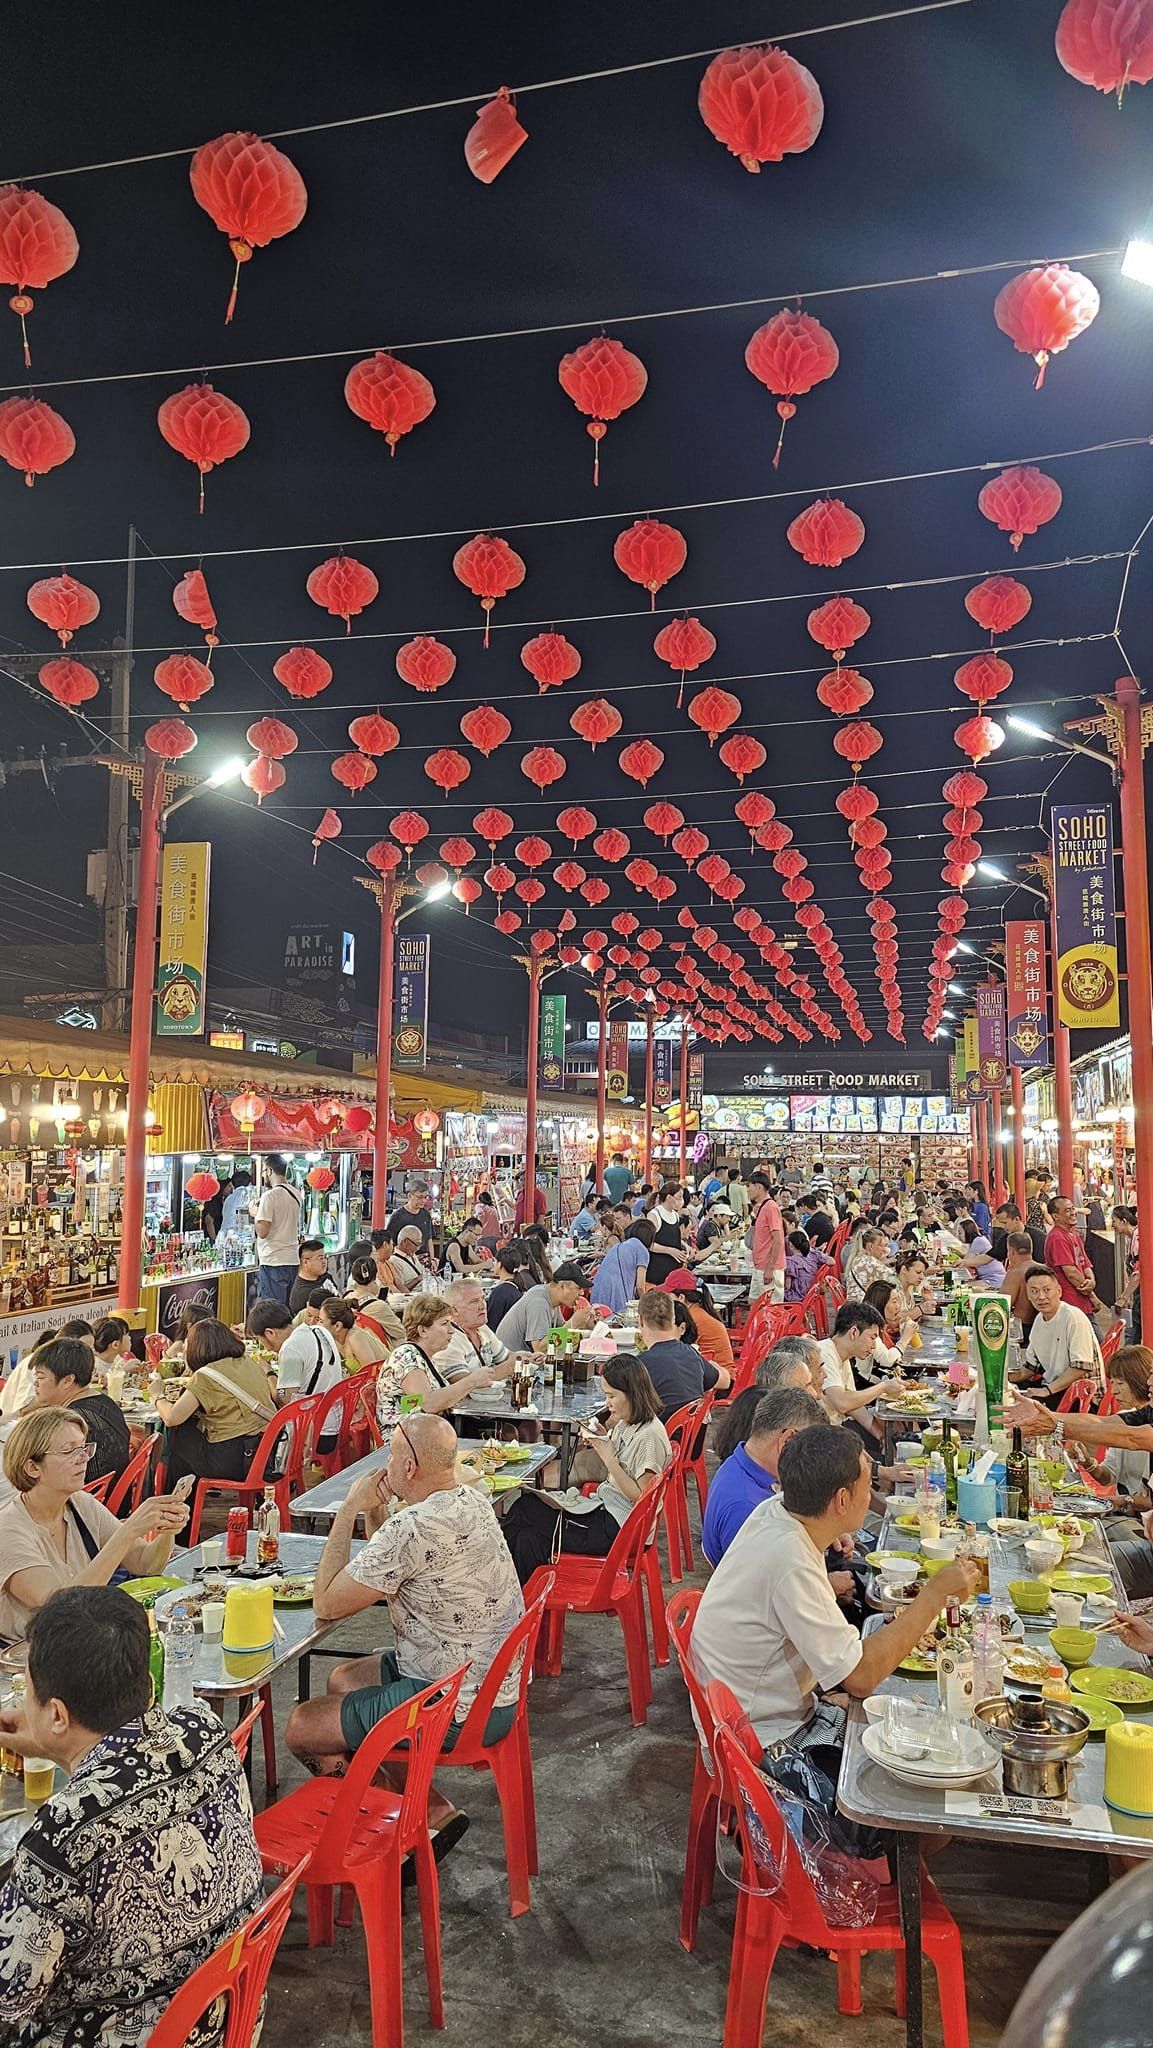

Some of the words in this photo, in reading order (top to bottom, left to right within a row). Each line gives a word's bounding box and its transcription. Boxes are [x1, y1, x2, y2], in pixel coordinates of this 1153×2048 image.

[1058, 815, 1106, 840] SOHO
[1058, 840, 1085, 851] STREET
[1087, 838, 1107, 850] FOOD
[1059, 849, 1107, 867] MARKET
[164, 854, 188, 975] 美食街市场
[1089, 875, 1107, 955] 美食街市场
[285, 934, 323, 956] ART
[399, 941, 425, 956] SOHO
[284, 955, 334, 968] PARADISE
[399, 961, 424, 971] MARKET
[1023, 928, 1042, 1022] 美食街市场
[979, 993, 1002, 1005] SOHO
[543, 1000, 555, 1061] 美食街市场
[611, 1024, 627, 1034] SOHO
[743, 1075, 773, 1086] SOHO
[781, 1075, 823, 1086] STREET
[829, 1075, 864, 1086] FOOD
[868, 1075, 920, 1086] MARKET
[11, 1323, 18, 1335] &
[20, 1316, 46, 1334] Italian
[47, 1314, 66, 1328] Soda
